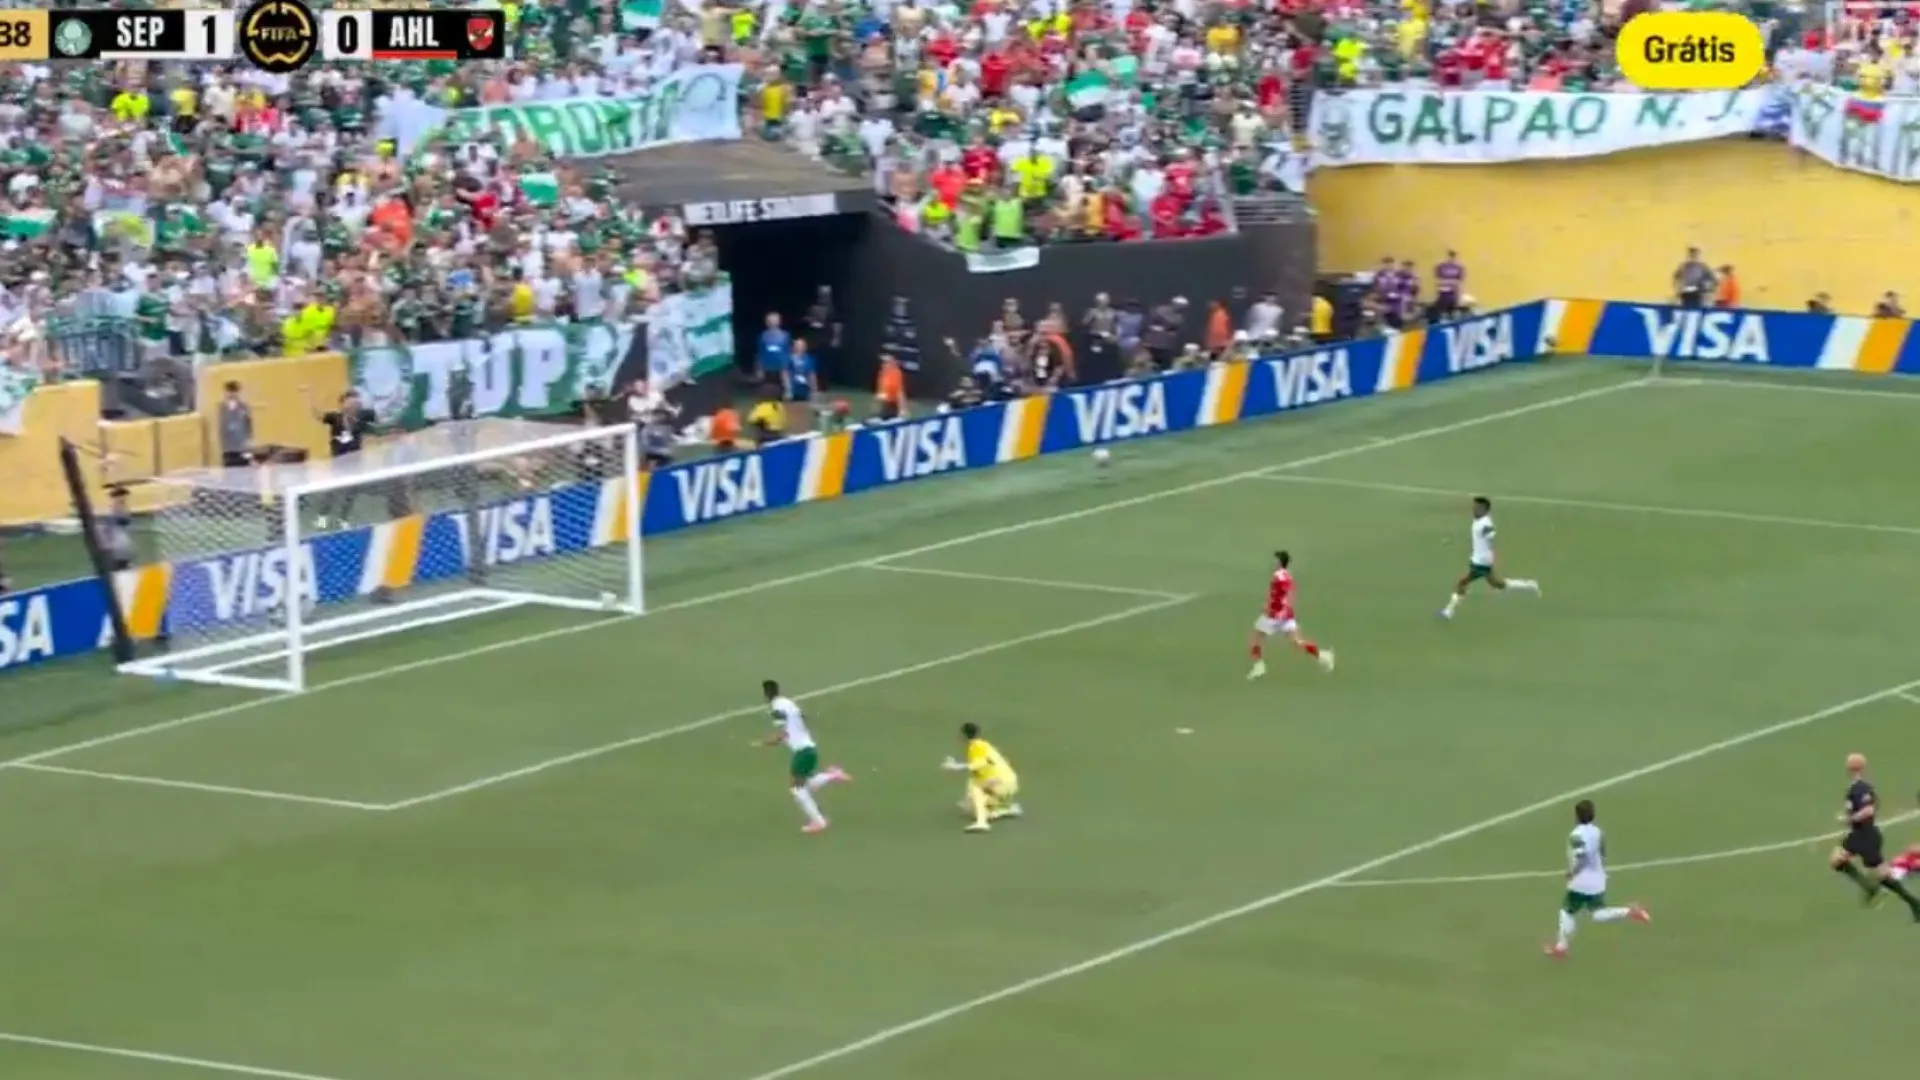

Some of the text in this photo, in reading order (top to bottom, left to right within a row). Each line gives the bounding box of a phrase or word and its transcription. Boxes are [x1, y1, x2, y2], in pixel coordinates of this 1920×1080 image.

[1445, 313, 1514, 373] VISA
[1630, 306, 1771, 362] VISA
[1270, 348, 1352, 409] VISA
[1070, 381, 1169, 444] VISA
[872, 416, 968, 481] VISA
[673, 454, 766, 523] VISA
[0, 594, 54, 669] SA
